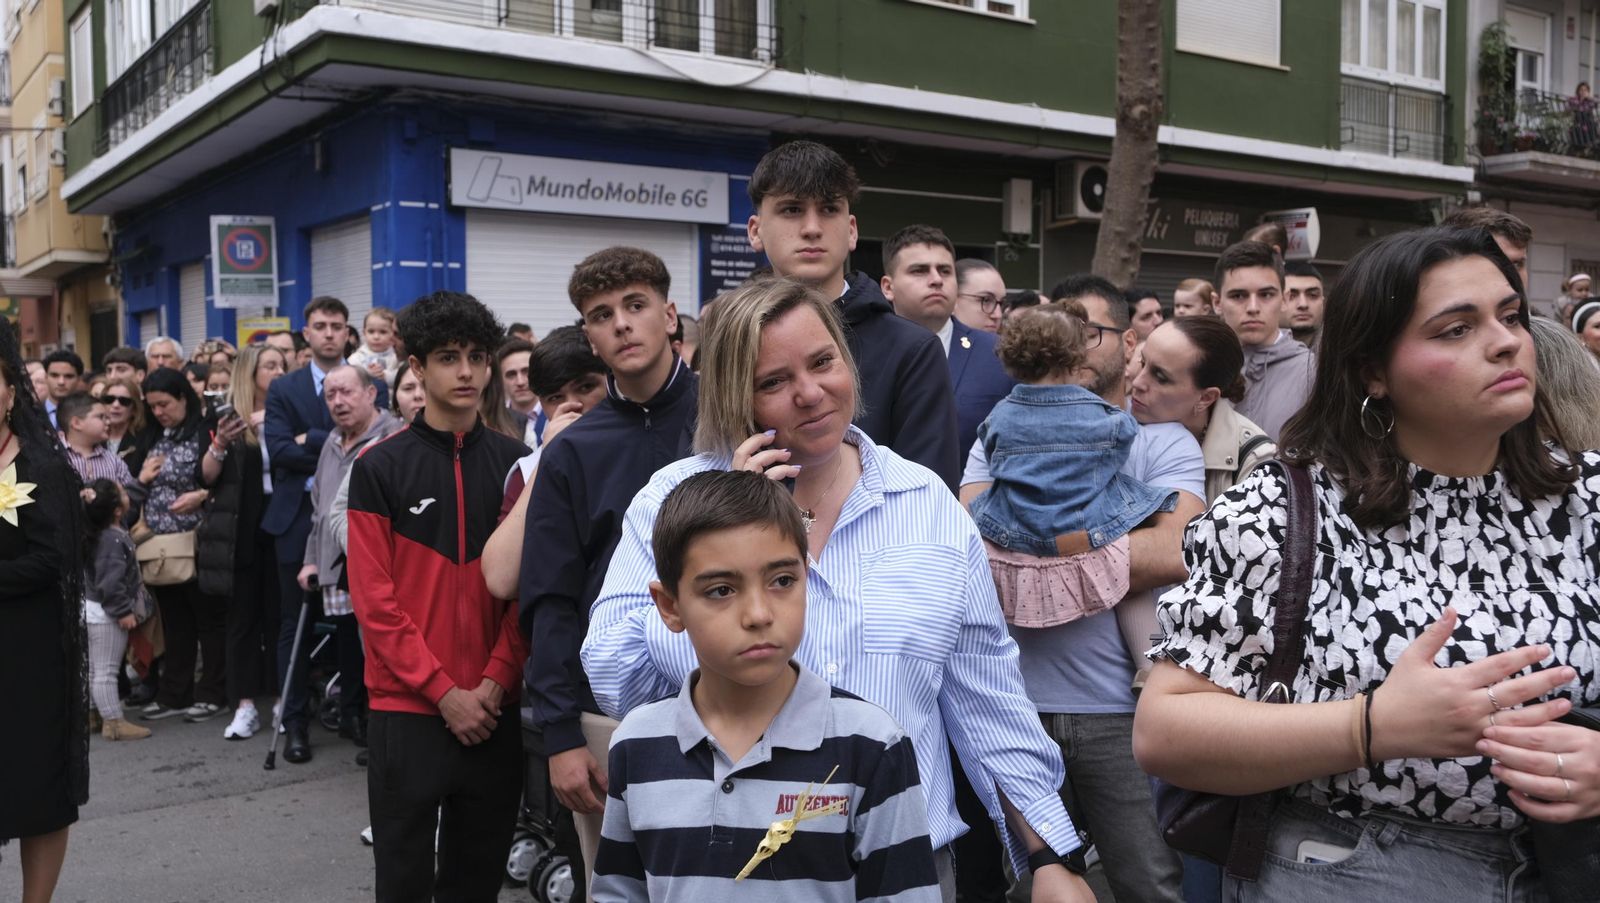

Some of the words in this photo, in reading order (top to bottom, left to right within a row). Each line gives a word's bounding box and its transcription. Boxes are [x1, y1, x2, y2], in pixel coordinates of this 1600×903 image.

[526, 174, 676, 207] MundoMobile
[680, 187, 709, 209] 6G
[1193, 229, 1230, 248] UNISEX
